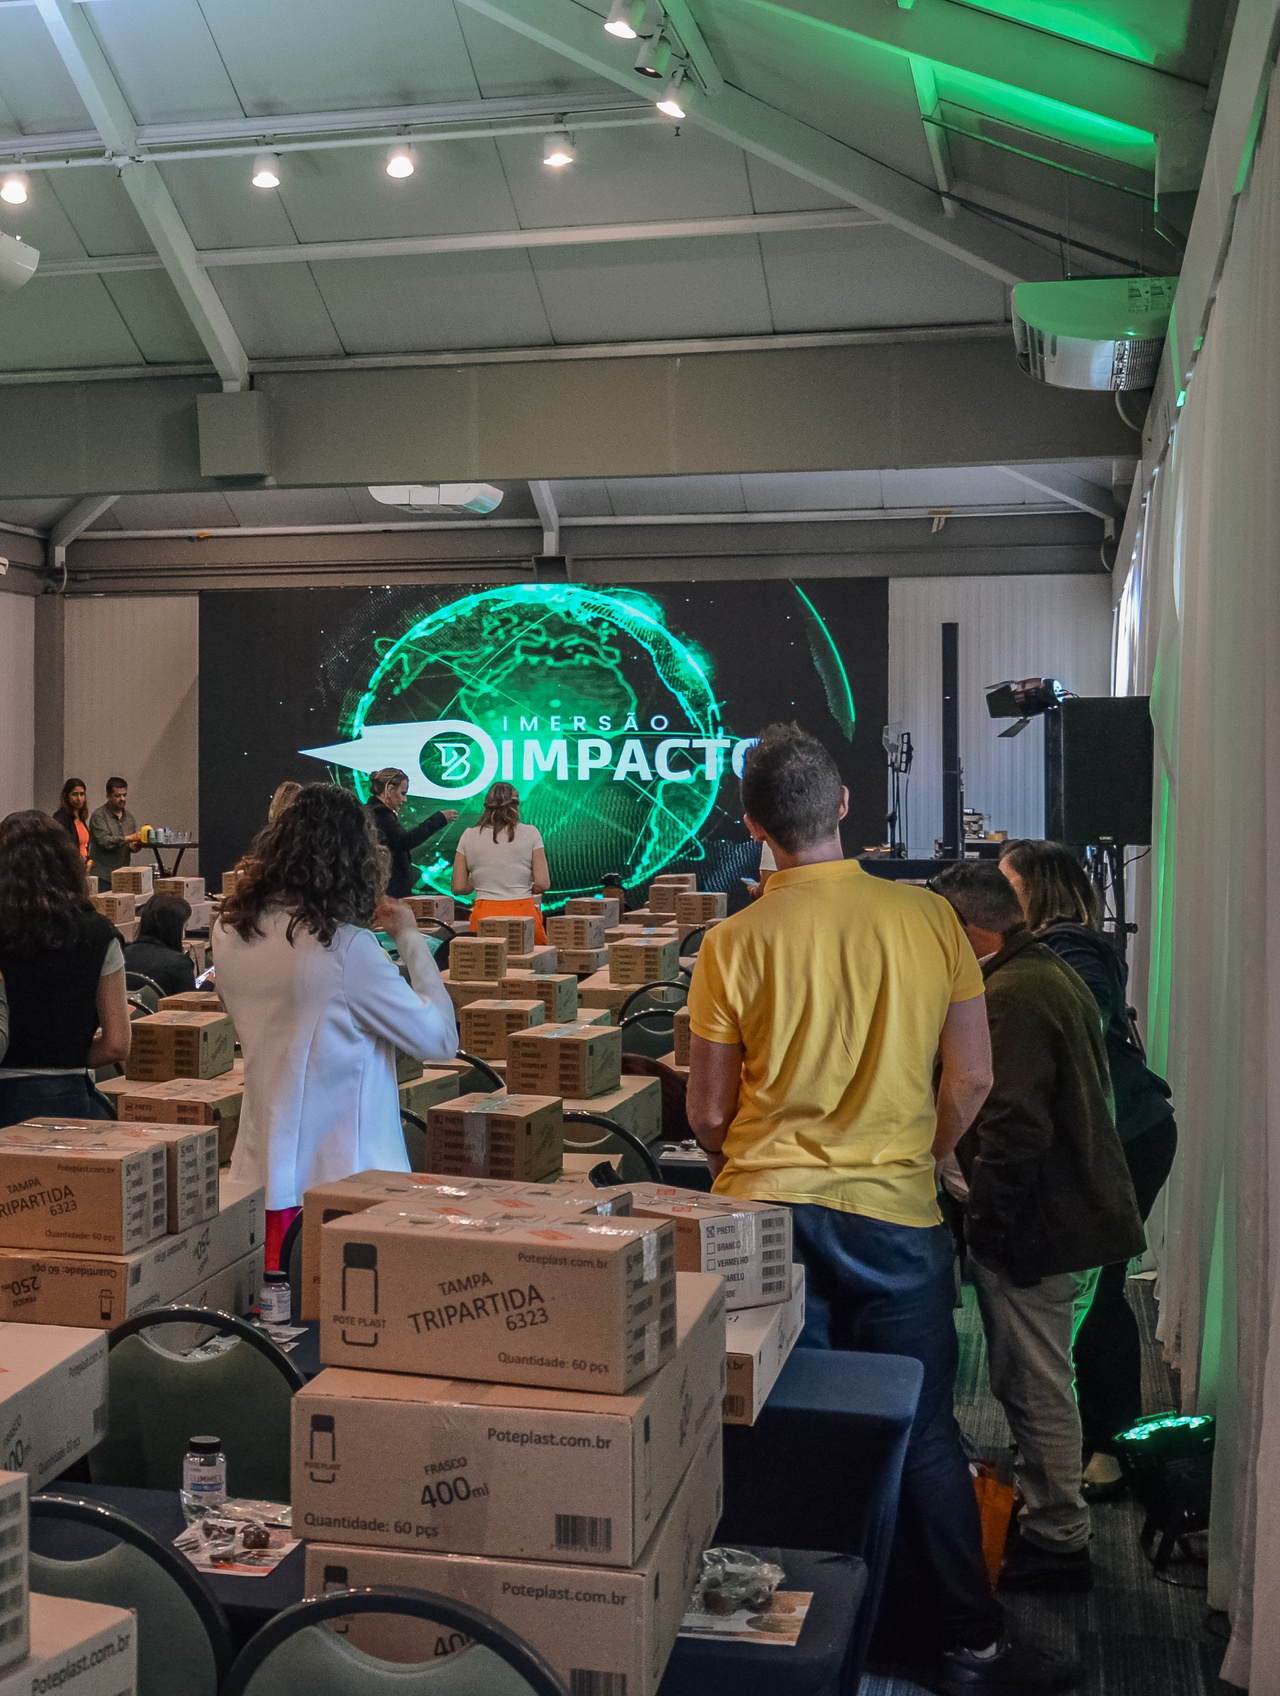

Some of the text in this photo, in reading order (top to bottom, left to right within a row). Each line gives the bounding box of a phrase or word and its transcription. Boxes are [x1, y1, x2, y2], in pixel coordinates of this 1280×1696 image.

[503, 712, 669, 731] IMERSÃO
[6, 1178, 41, 1195] TAMPA
[50, 1201, 78, 1216] 6323
[717, 1225, 735, 1235] PRETO
[717, 1240, 741, 1252] BRANCO
[518, 1252, 607, 1269] Poteplast.com.br
[717, 1256, 749, 1267] VERMELHO
[32, 1265, 116, 1278] Quantidade: 60 pçs
[723, 1273, 744, 1282] ARELO
[437, 1272, 493, 1296] TAMPA
[408, 1284, 545, 1334] TRIPARTIDA
[333, 1315, 386, 1328] POTE PLAST
[505, 1307, 549, 1331] 6323
[498, 1352, 609, 1373] Quantidade: 60 pçs
[487, 1427, 611, 1450] Poteplast.com.br
[424, 1457, 467, 1476] FRASCO
[420, 1476, 490, 1509] 400ml
[304, 1512, 439, 1539] Quantidade: 60 pçs
[502, 1582, 626, 1606] Poteplast.com.br
[32, 1634, 130, 1695] Poteplast.com.br
